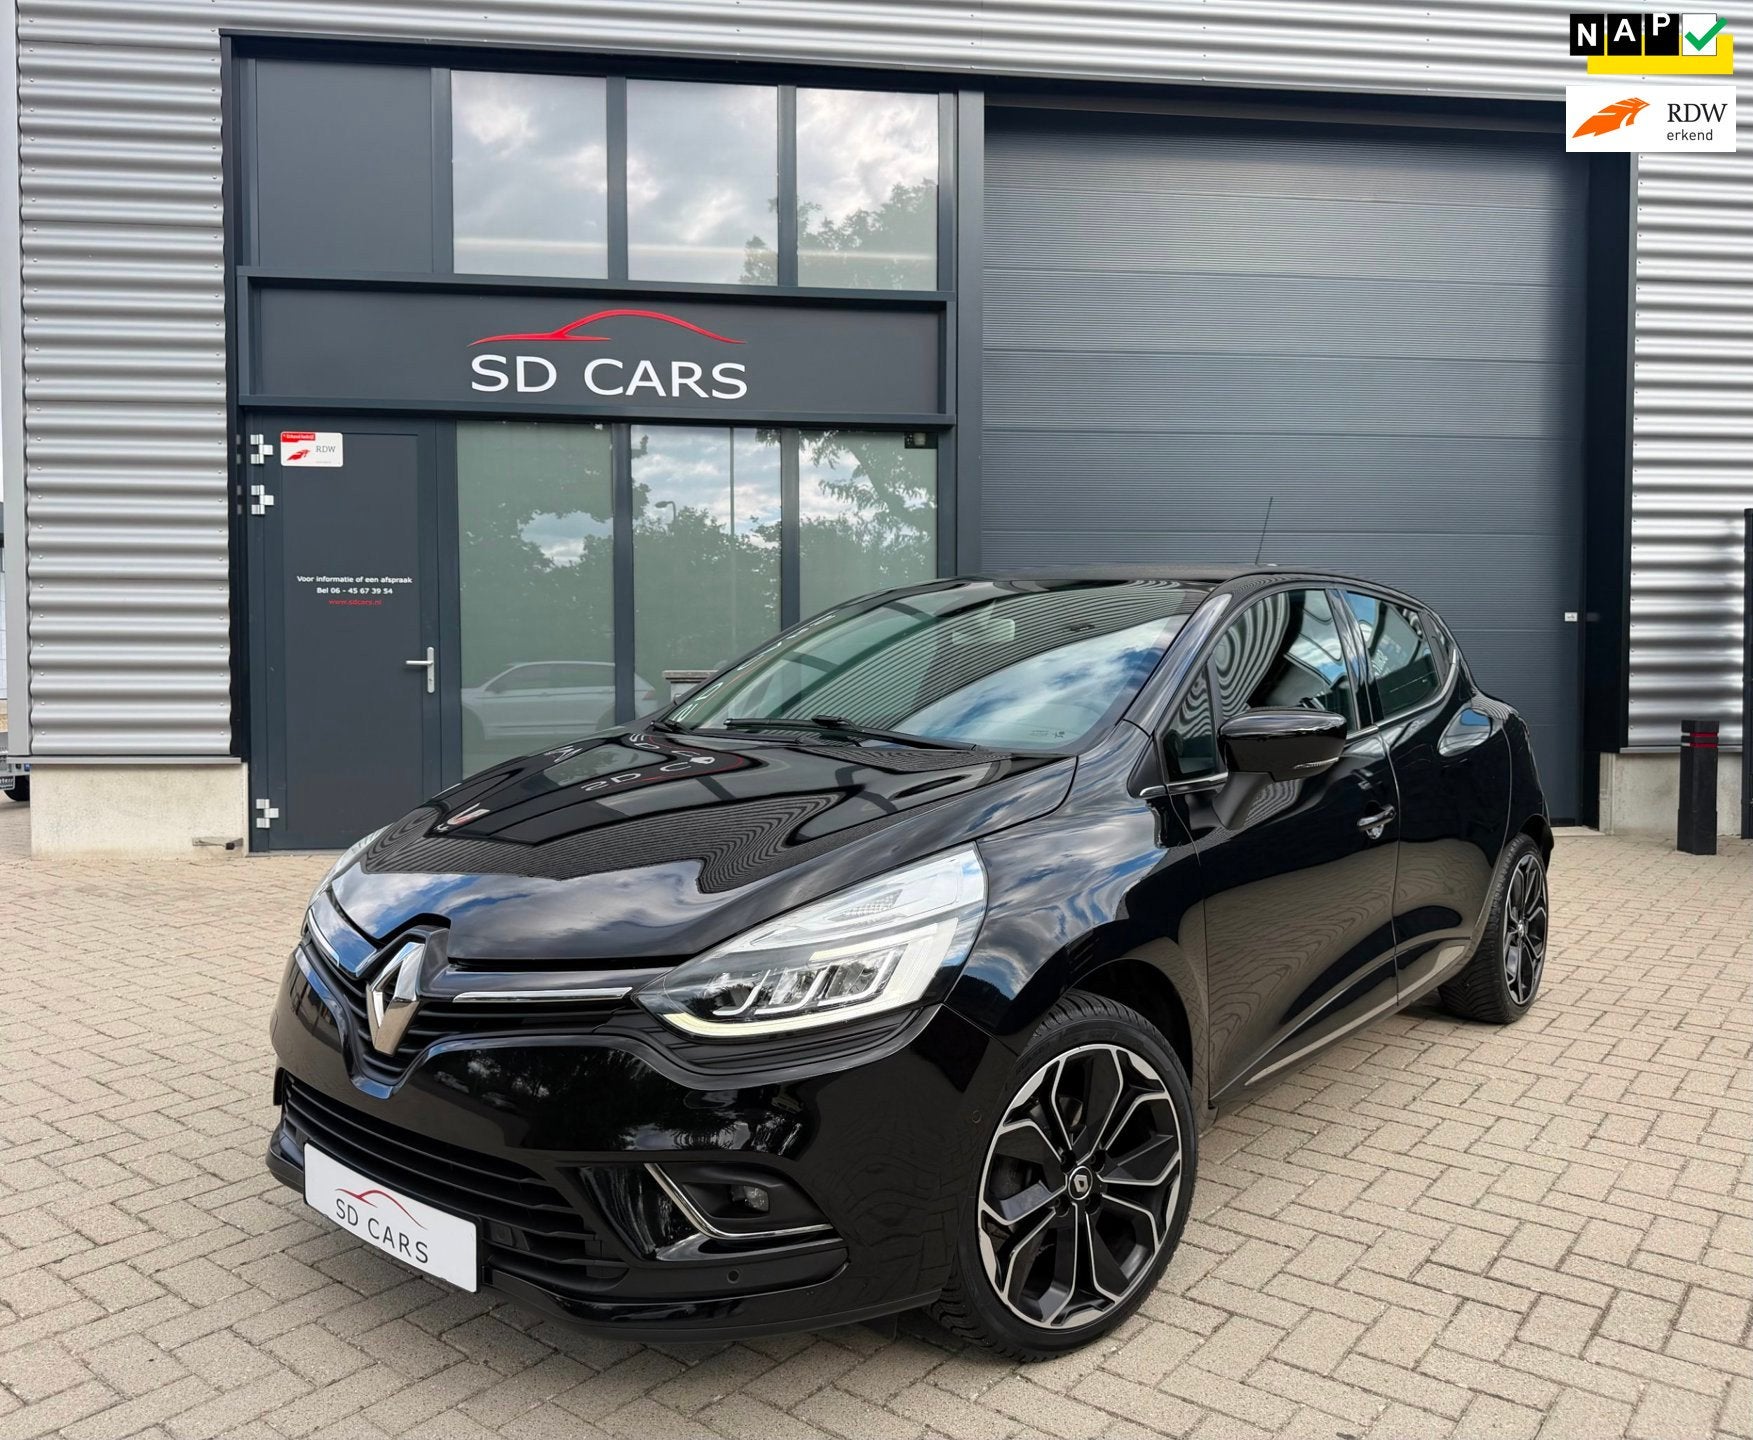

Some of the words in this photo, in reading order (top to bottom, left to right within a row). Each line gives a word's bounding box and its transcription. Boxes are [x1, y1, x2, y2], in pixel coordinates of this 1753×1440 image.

[471, 354, 557, 392] SD
[584, 358, 748, 400] CARS
[315, 445, 336, 453] RDW
[296, 575, 315, 583] Voor
[316, 575, 354, 583] informatie
[381, 576, 413, 584] afspraak
[360, 587, 370, 595] 67
[336, 1198, 359, 1227] SD
[367, 1217, 429, 1264] CARS
